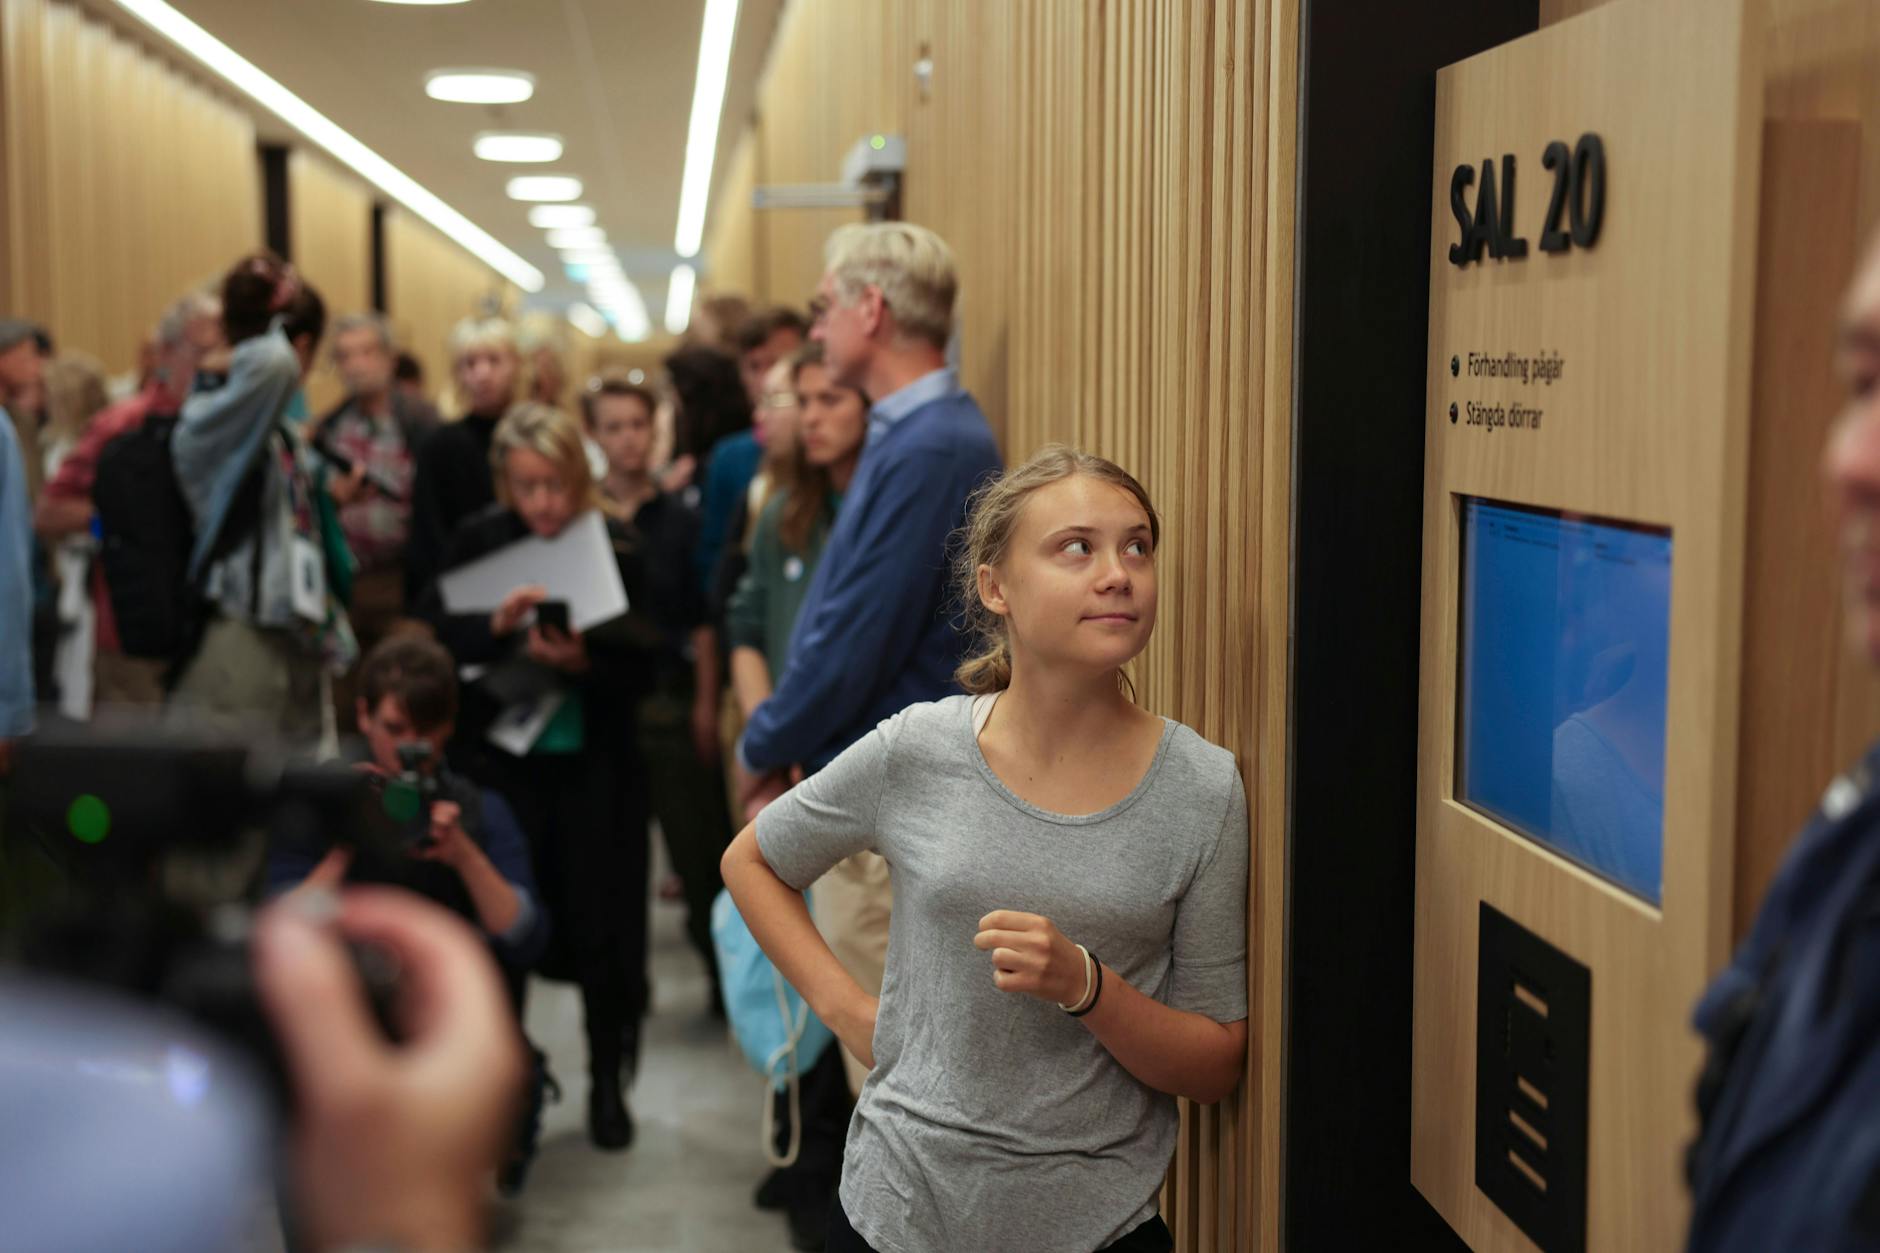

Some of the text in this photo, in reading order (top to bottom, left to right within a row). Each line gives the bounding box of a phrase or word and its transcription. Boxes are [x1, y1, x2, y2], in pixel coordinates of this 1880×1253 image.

[1449, 132, 1608, 267] SAL 20
[1468, 349, 1564, 386] Förhandling pågår
[1466, 401, 1543, 432] Stängda dörrar
